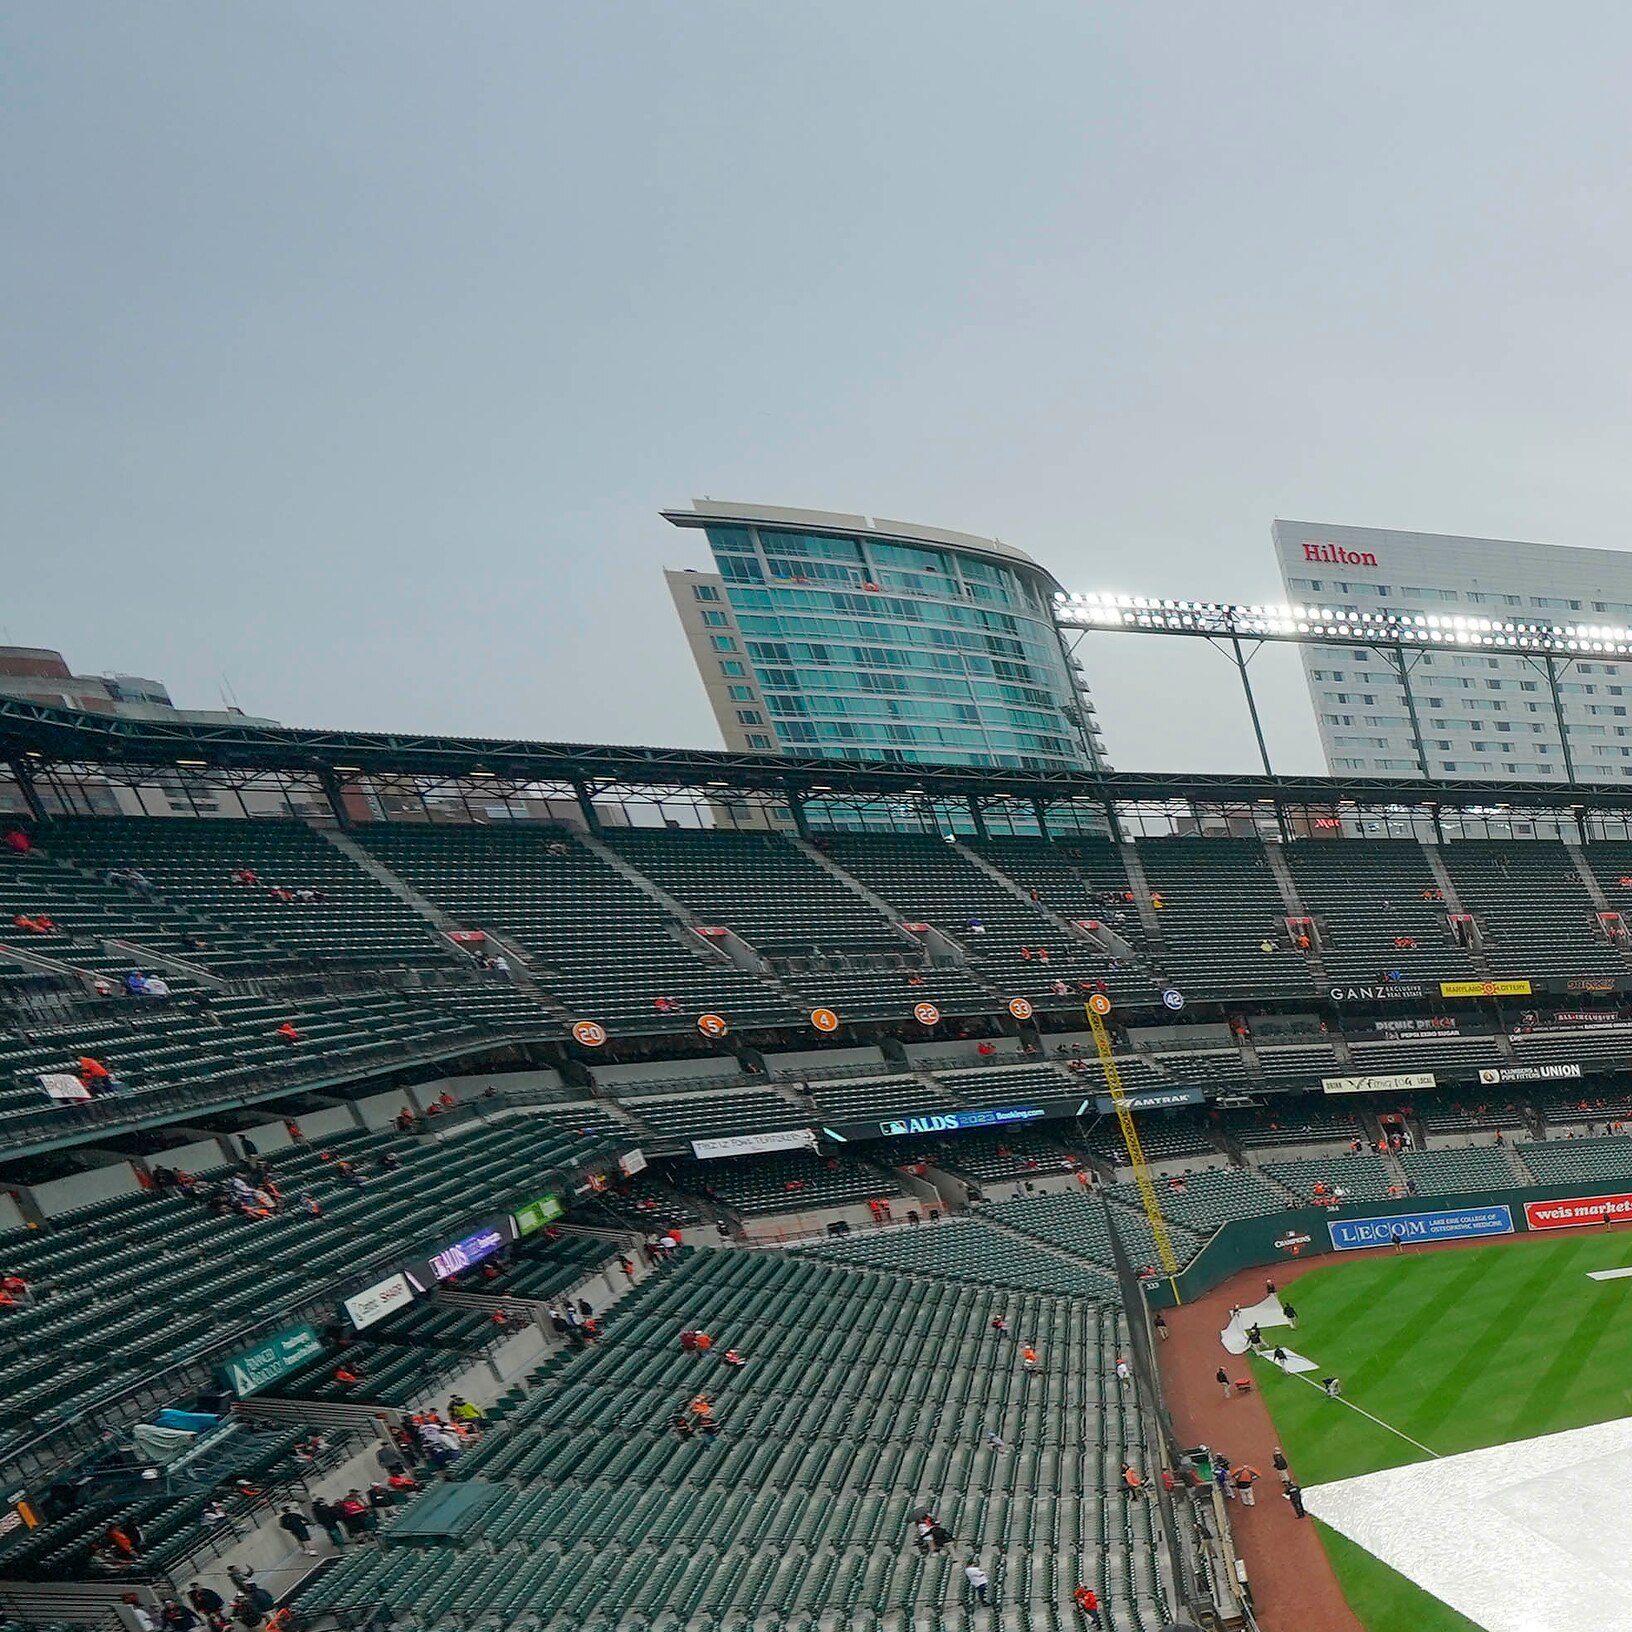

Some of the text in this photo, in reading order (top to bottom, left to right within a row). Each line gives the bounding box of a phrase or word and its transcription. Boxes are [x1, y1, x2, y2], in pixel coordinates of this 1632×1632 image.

[1302, 543, 1378, 567] Hilton
[1166, 994, 1181, 1006] 42
[1330, 987, 1386, 1000] GANZ
[1013, 1002, 1029, 1015] 33
[1097, 999, 1103, 1010] 8
[819, 1014, 828, 1026] 4
[917, 1007, 935, 1021] 22
[707, 1020, 719, 1033] 5
[1375, 1021, 1414, 1031] PICNIC
[579, 1027, 599, 1041] 20
[1541, 1064, 1581, 1078] UNION
[1134, 1094, 1189, 1107] AMTRAK
[909, 1109, 1045, 1134] ALDS 2023 Booking.com
[1536, 1205, 1571, 1220] weis
